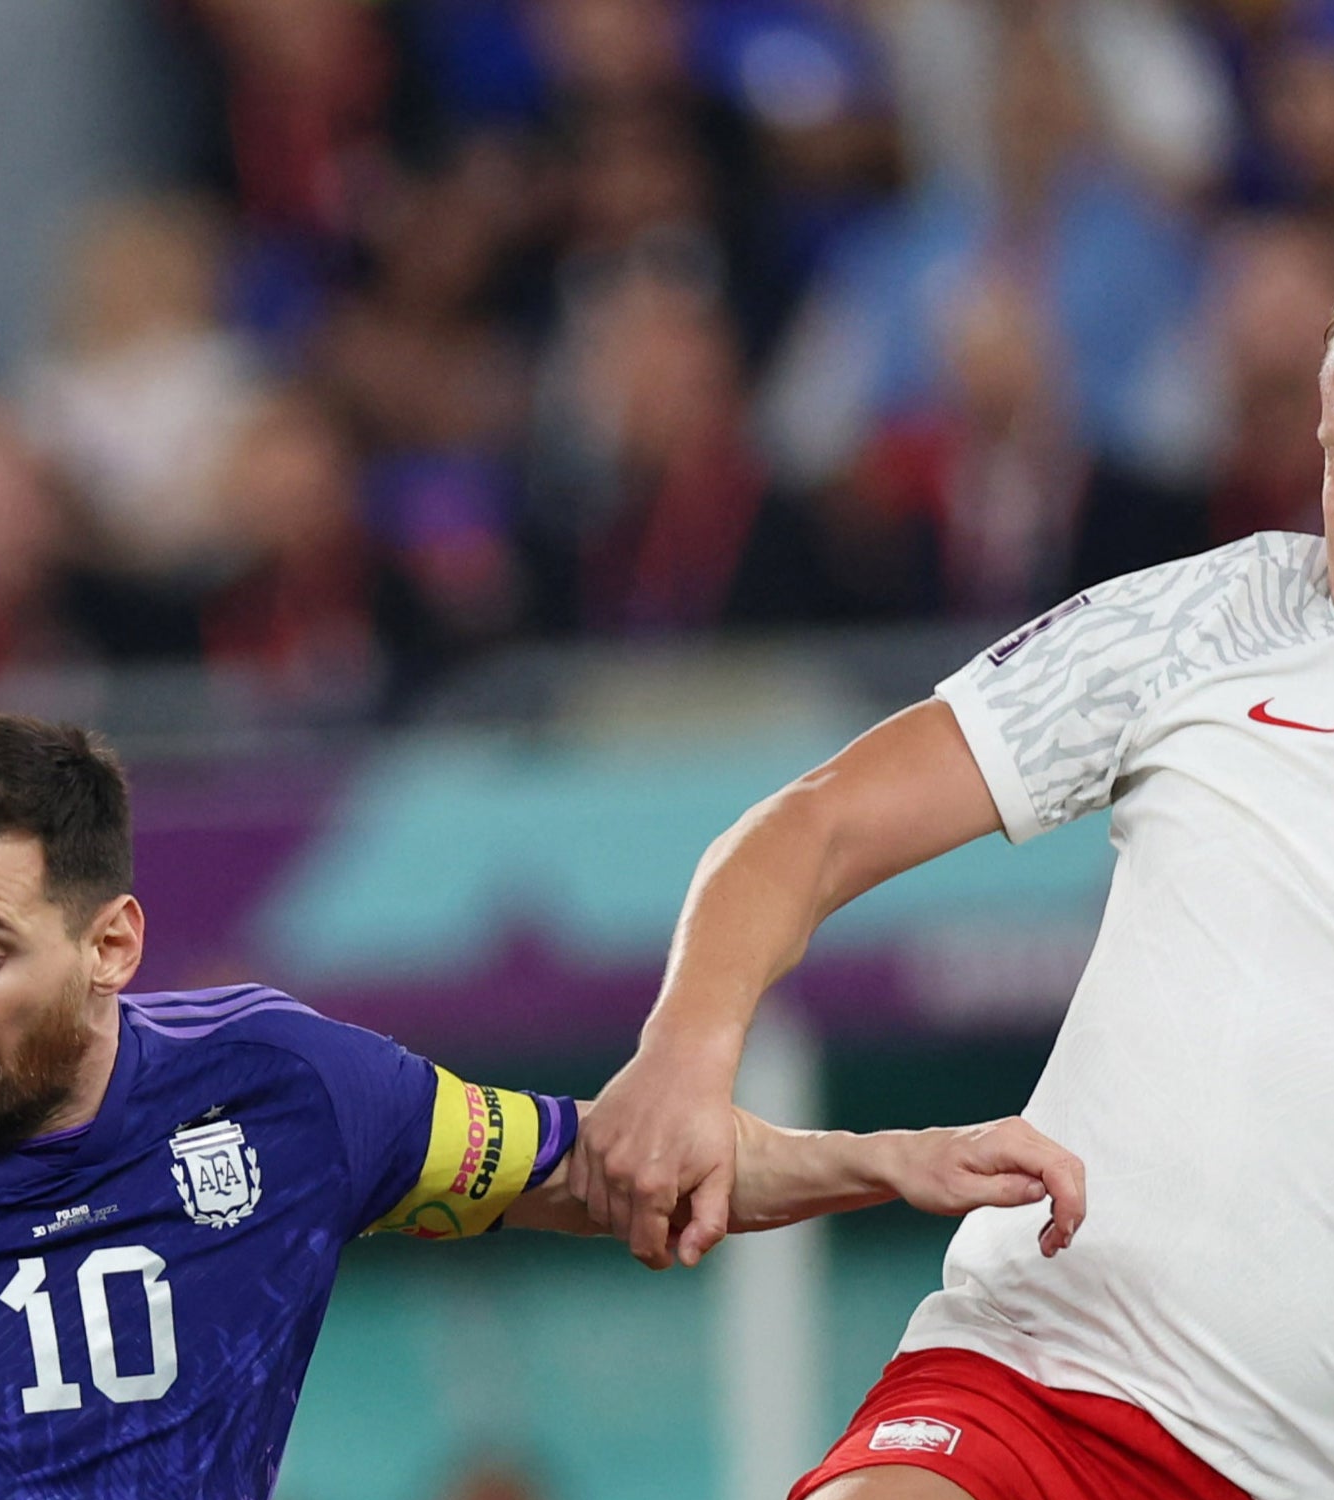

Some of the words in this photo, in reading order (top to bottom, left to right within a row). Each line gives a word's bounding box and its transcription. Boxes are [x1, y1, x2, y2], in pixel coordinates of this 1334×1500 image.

[198, 1150, 241, 1196] AFA
[469, 1086, 503, 1200] CHILDRE
[0, 1245, 178, 1414] 10
